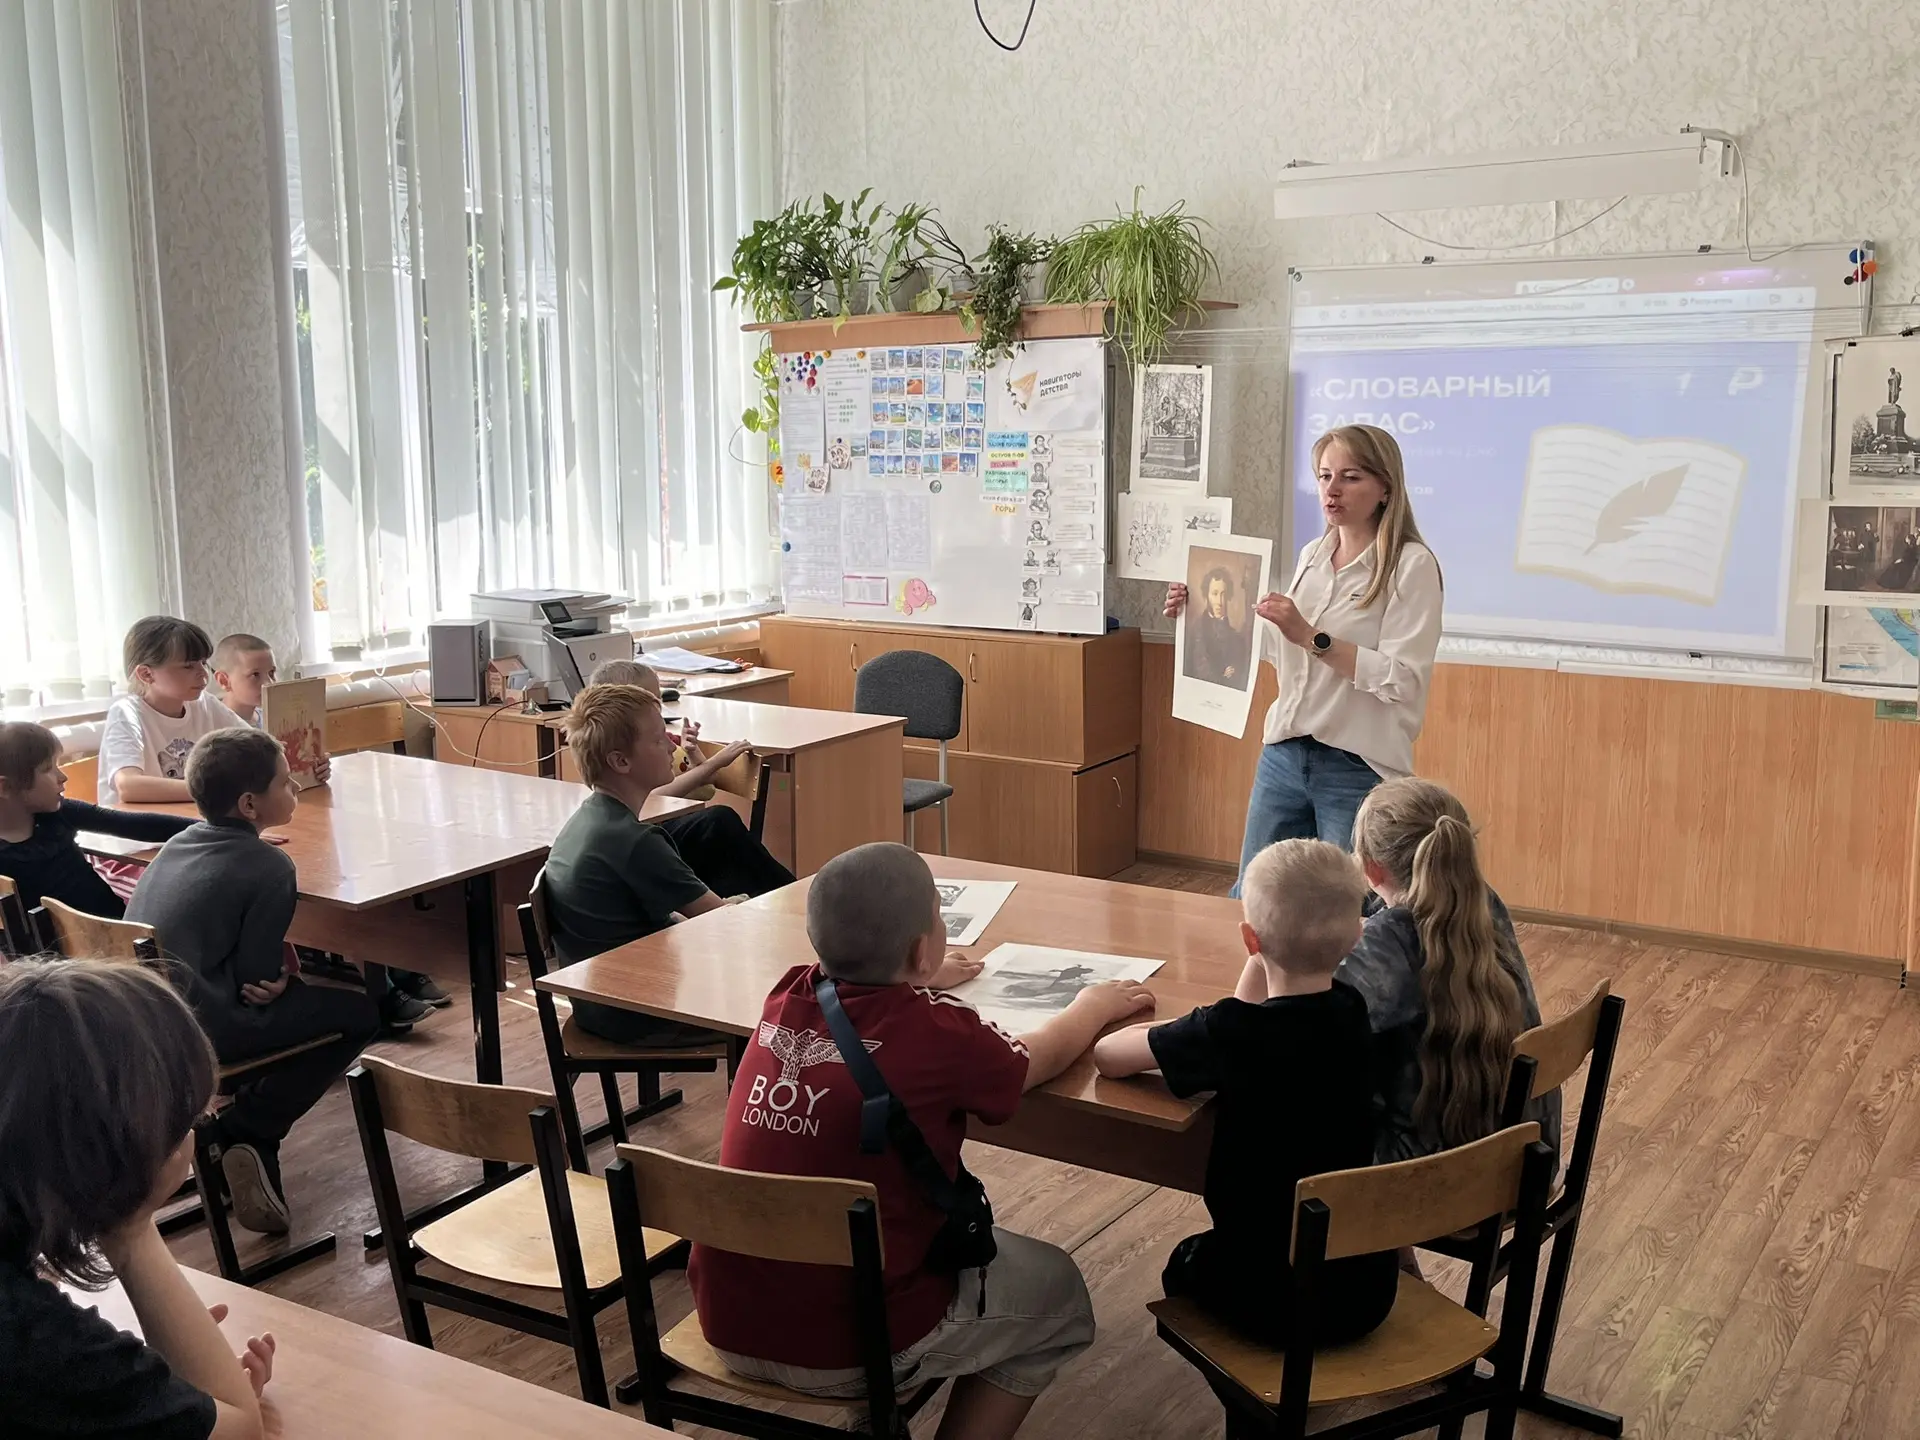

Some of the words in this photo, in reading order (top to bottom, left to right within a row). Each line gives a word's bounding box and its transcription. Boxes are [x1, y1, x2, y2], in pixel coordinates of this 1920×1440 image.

[1039, 370, 1082, 388] НАВИГАТОРЫ
[1040, 383, 1069, 397] ДЕТСТВА
[1309, 368, 1550, 400] «СЛОВАРНЫЙ
[747, 1074, 831, 1116] BOY
[741, 1105, 820, 1137] LONDON
